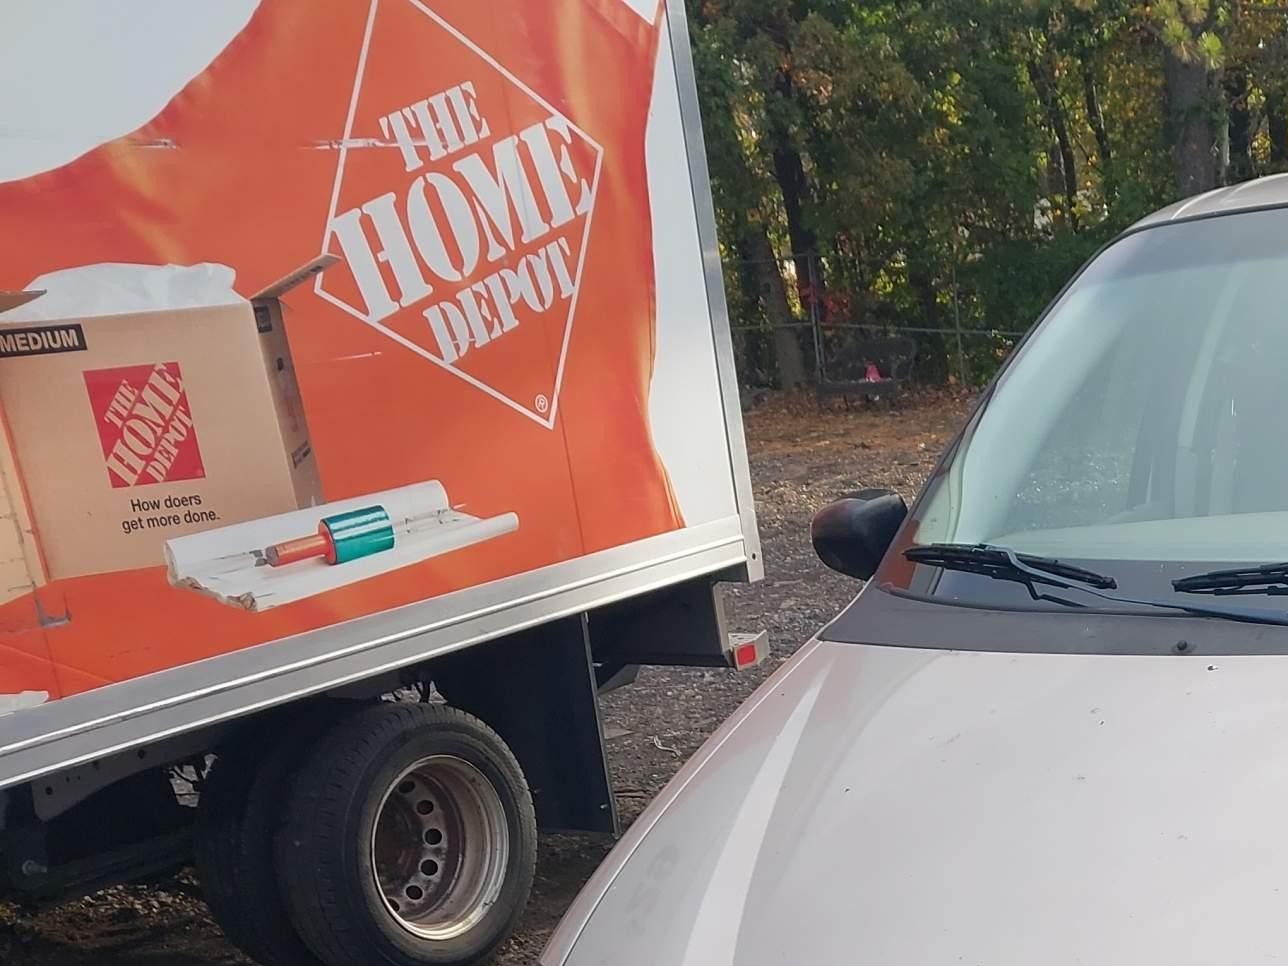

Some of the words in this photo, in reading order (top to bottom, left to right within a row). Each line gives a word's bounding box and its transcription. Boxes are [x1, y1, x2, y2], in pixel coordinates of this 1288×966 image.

[379, 81, 491, 172] THE
[329, 115, 595, 323] HOME
[423, 237, 577, 365] DEPOT
[0, 328, 79, 352] MEDIUM
[104, 379, 139, 429] THE
[106, 362, 183, 487] HOME
[146, 406, 194, 482] DEPOT
[121, 517, 145, 534] get
[147, 513, 181, 528] more
[184, 509, 220, 524] done.
[130, 497, 161, 513] How
[164, 494, 202, 509] doers
